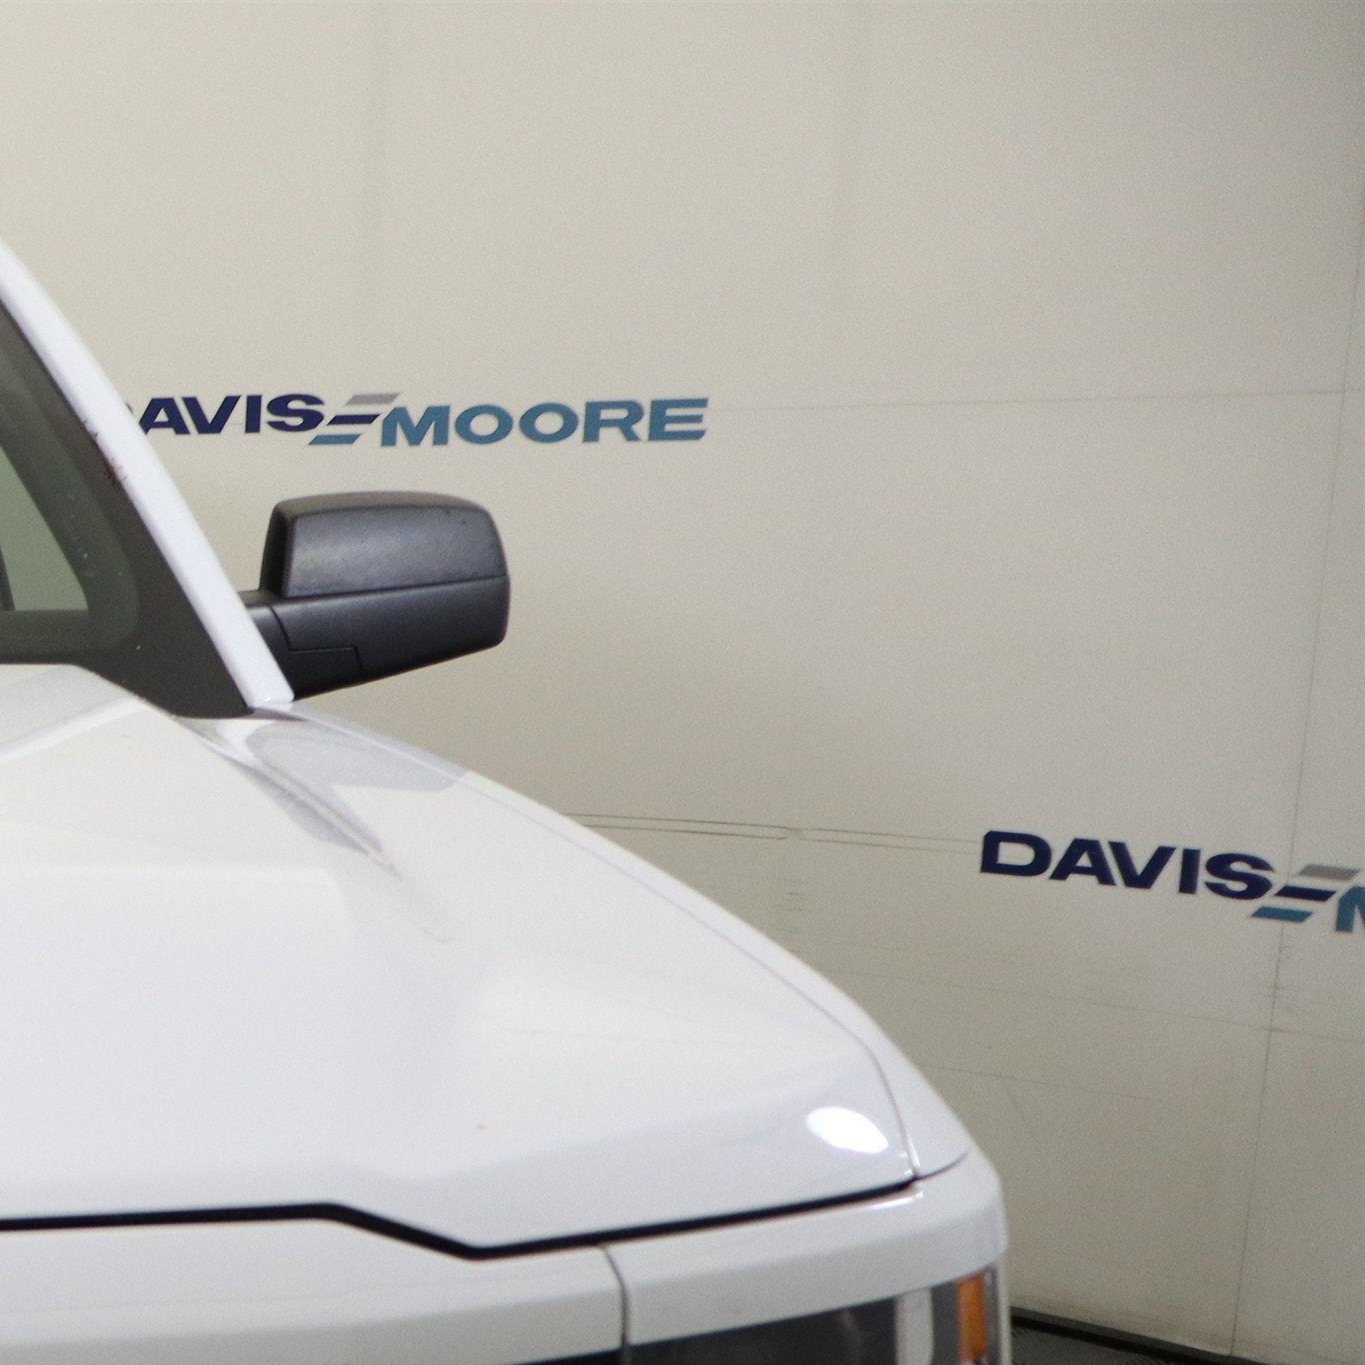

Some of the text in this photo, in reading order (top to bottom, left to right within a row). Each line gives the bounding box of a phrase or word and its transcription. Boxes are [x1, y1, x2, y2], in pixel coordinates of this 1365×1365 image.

[137, 393, 708, 447] AVIS MOORE
[980, 830, 1276, 900] DAVIS
